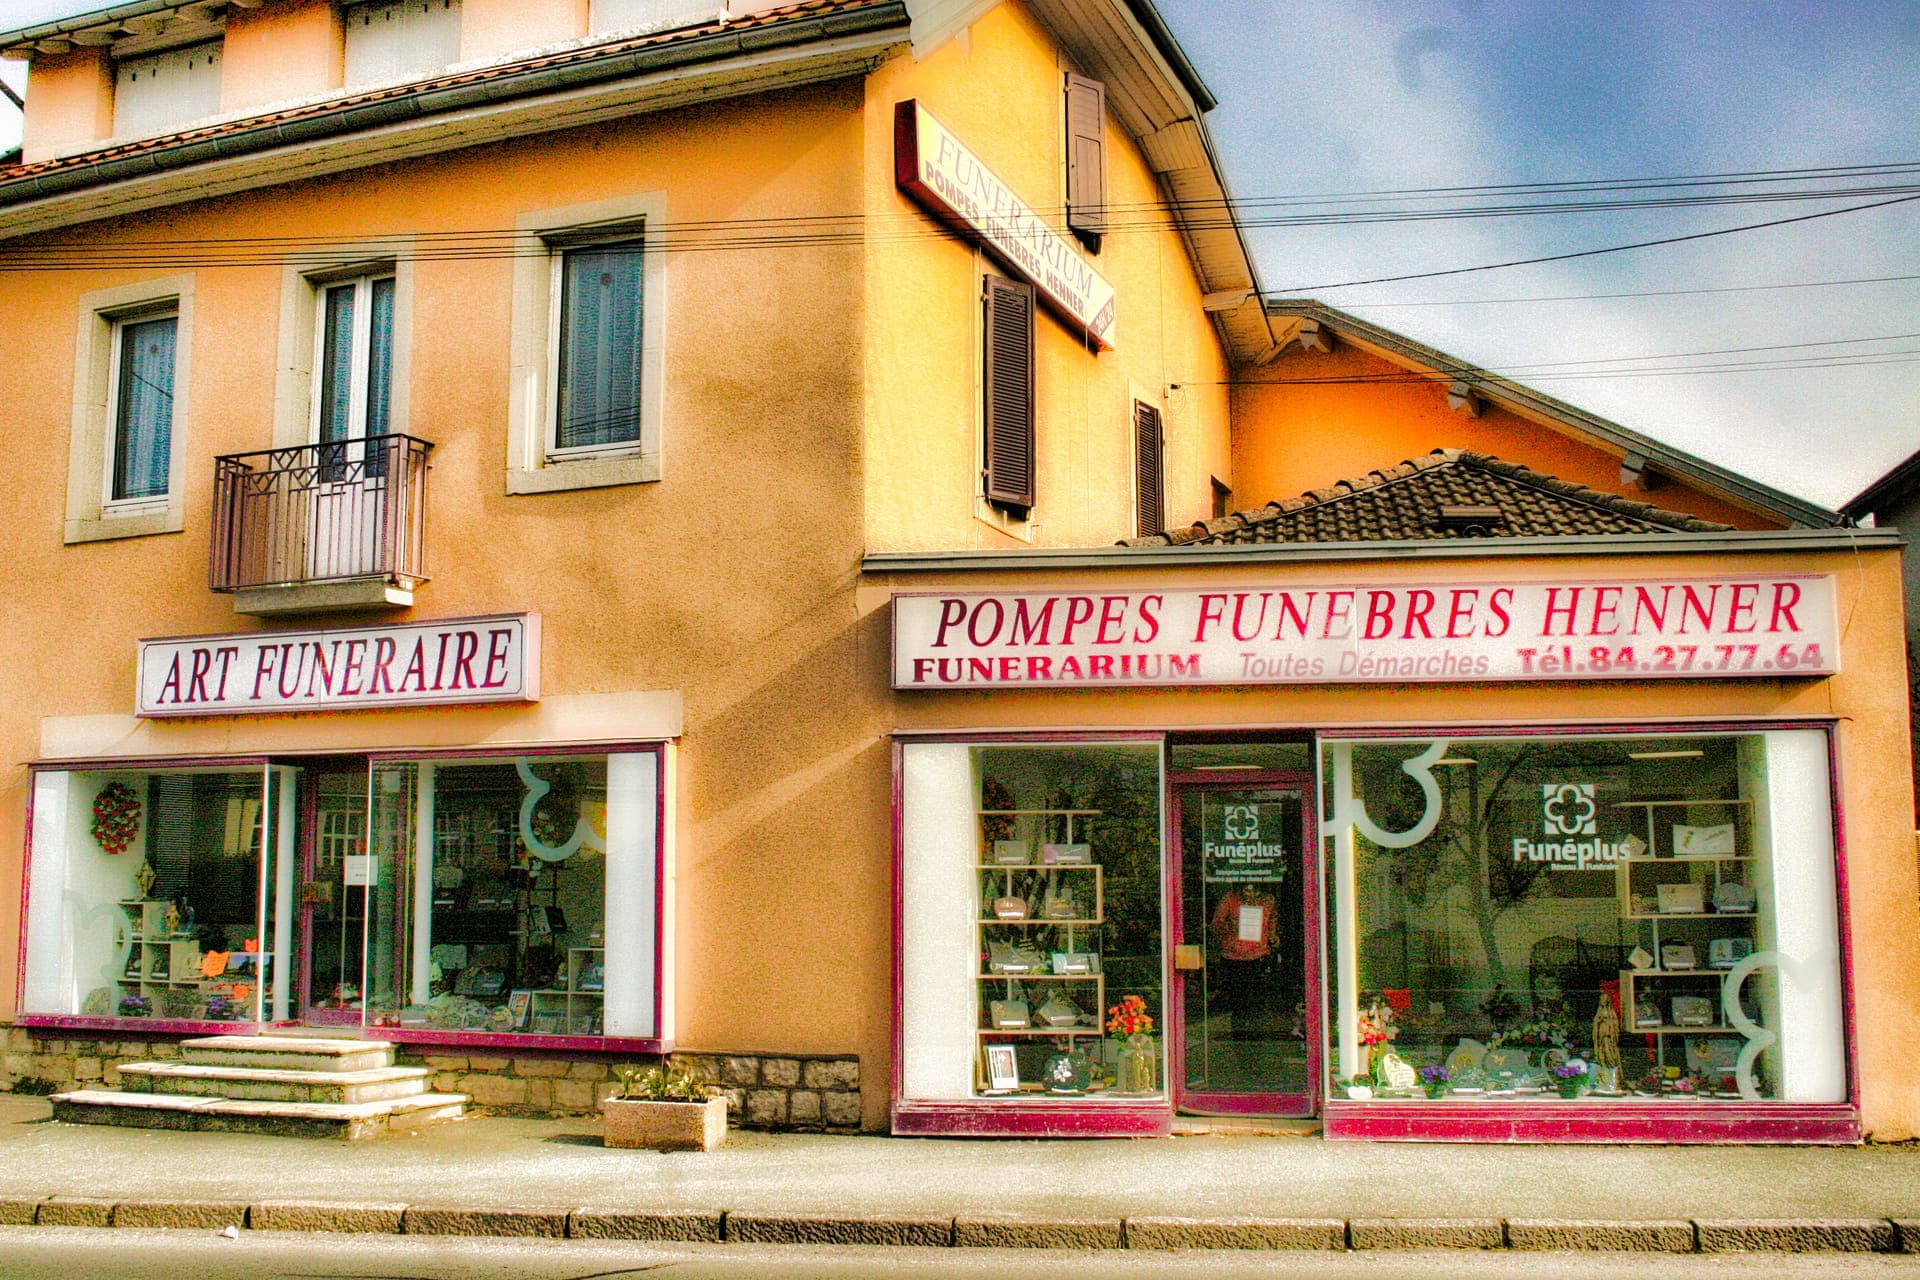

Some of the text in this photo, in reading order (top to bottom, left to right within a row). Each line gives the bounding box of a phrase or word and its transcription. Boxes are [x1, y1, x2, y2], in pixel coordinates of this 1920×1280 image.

[925, 160, 979, 224] POMPES
[986, 215, 1042, 279] FUNEBRES
[1046, 268, 1085, 318] HENNER
[936, 133, 1094, 299] FUNERARIUM
[931, 582, 1803, 648] POMPES FUNEBRES HENNER
[156, 628, 512, 704] ART FUNERAIRE
[912, 653, 1203, 683] FUNERARIUM
[1238, 652, 1325, 679] Toutes
[1337, 647, 1490, 678] Démarches
[1205, 842, 1282, 863] Funéplus
[1513, 838, 1631, 870] Funéplus
